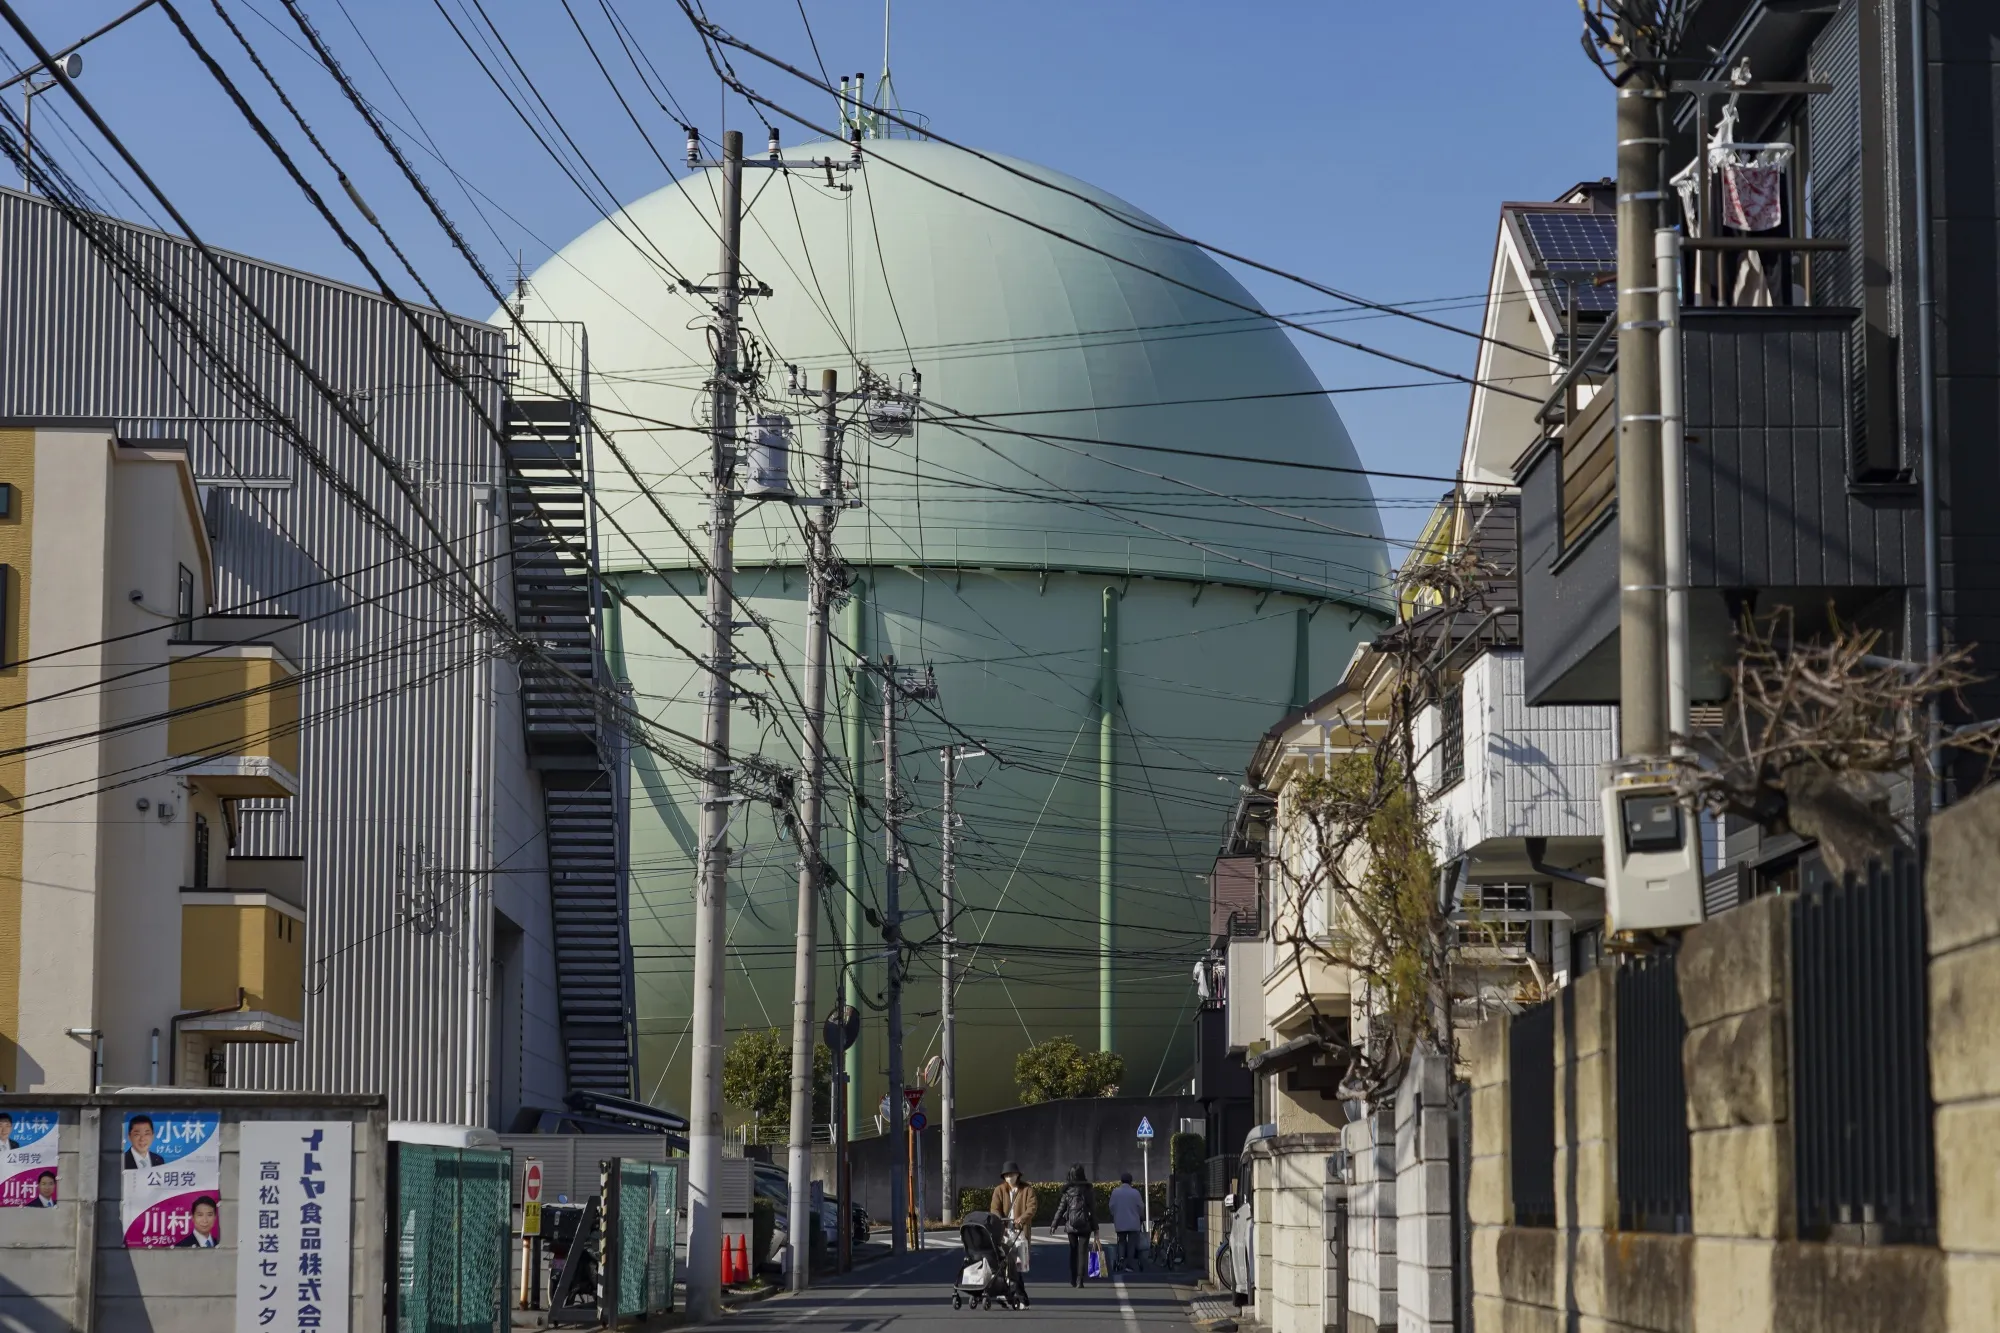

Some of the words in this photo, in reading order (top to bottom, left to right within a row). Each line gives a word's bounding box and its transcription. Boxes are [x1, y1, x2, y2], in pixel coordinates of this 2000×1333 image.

[13, 1116, 49, 1134] 小林
[156, 1120, 206, 1144] 小林
[7, 1152, 42, 1165] 公明党
[156, 1145, 182, 1154] けんじ
[147, 1171, 196, 1188] 公明党
[3, 1180, 39, 1199] 川村
[142, 1211, 192, 1236] 川村
[298, 1128, 325, 1333] イトヤ食品株式会
[142, 1235, 176, 1246] ゆうだい
[258, 1160, 281, 1333] 高松配送センタ
